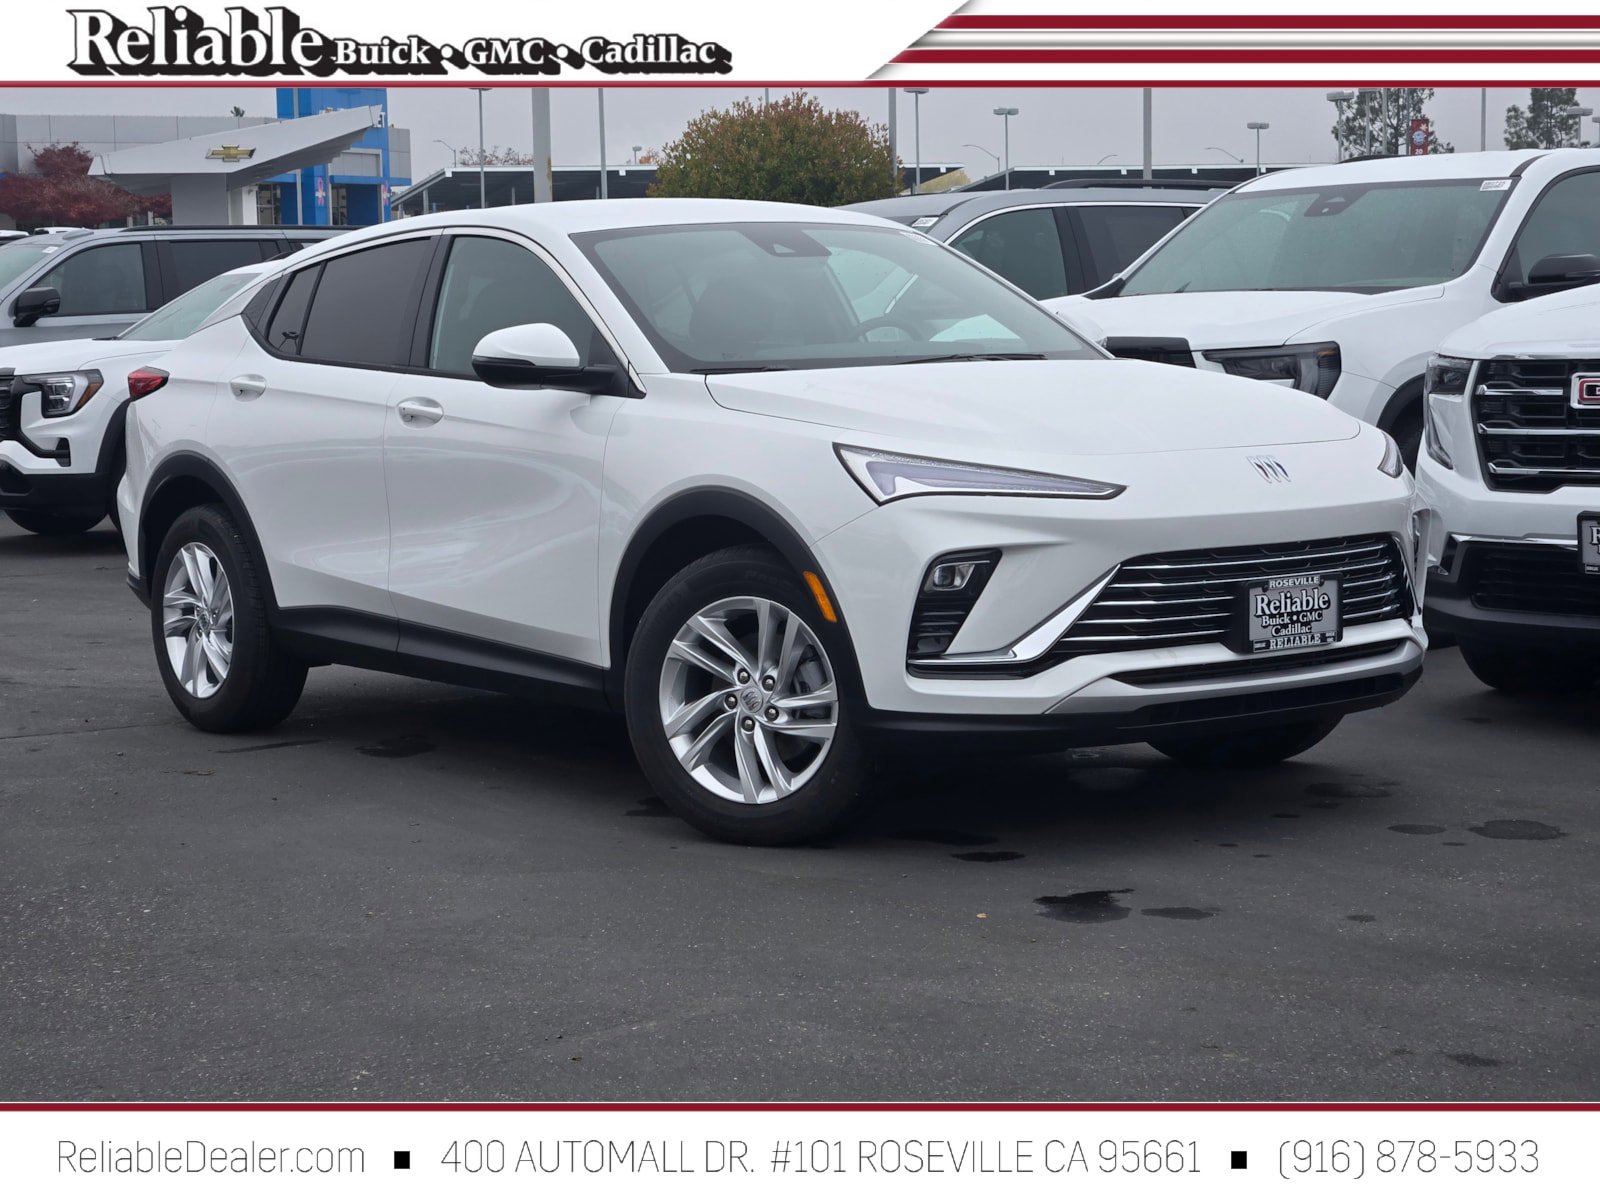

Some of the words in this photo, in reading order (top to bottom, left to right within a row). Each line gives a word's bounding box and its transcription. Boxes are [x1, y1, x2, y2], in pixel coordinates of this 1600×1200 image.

[1269, 576, 1319, 588] ROSEVILLE
[1255, 588, 1329, 616] Reliable
[1261, 613, 1291, 627] Buick
[1299, 611, 1323, 622] GMC
[1271, 624, 1311, 636] Cadillac
[1269, 634, 1321, 649] RELIABLE
